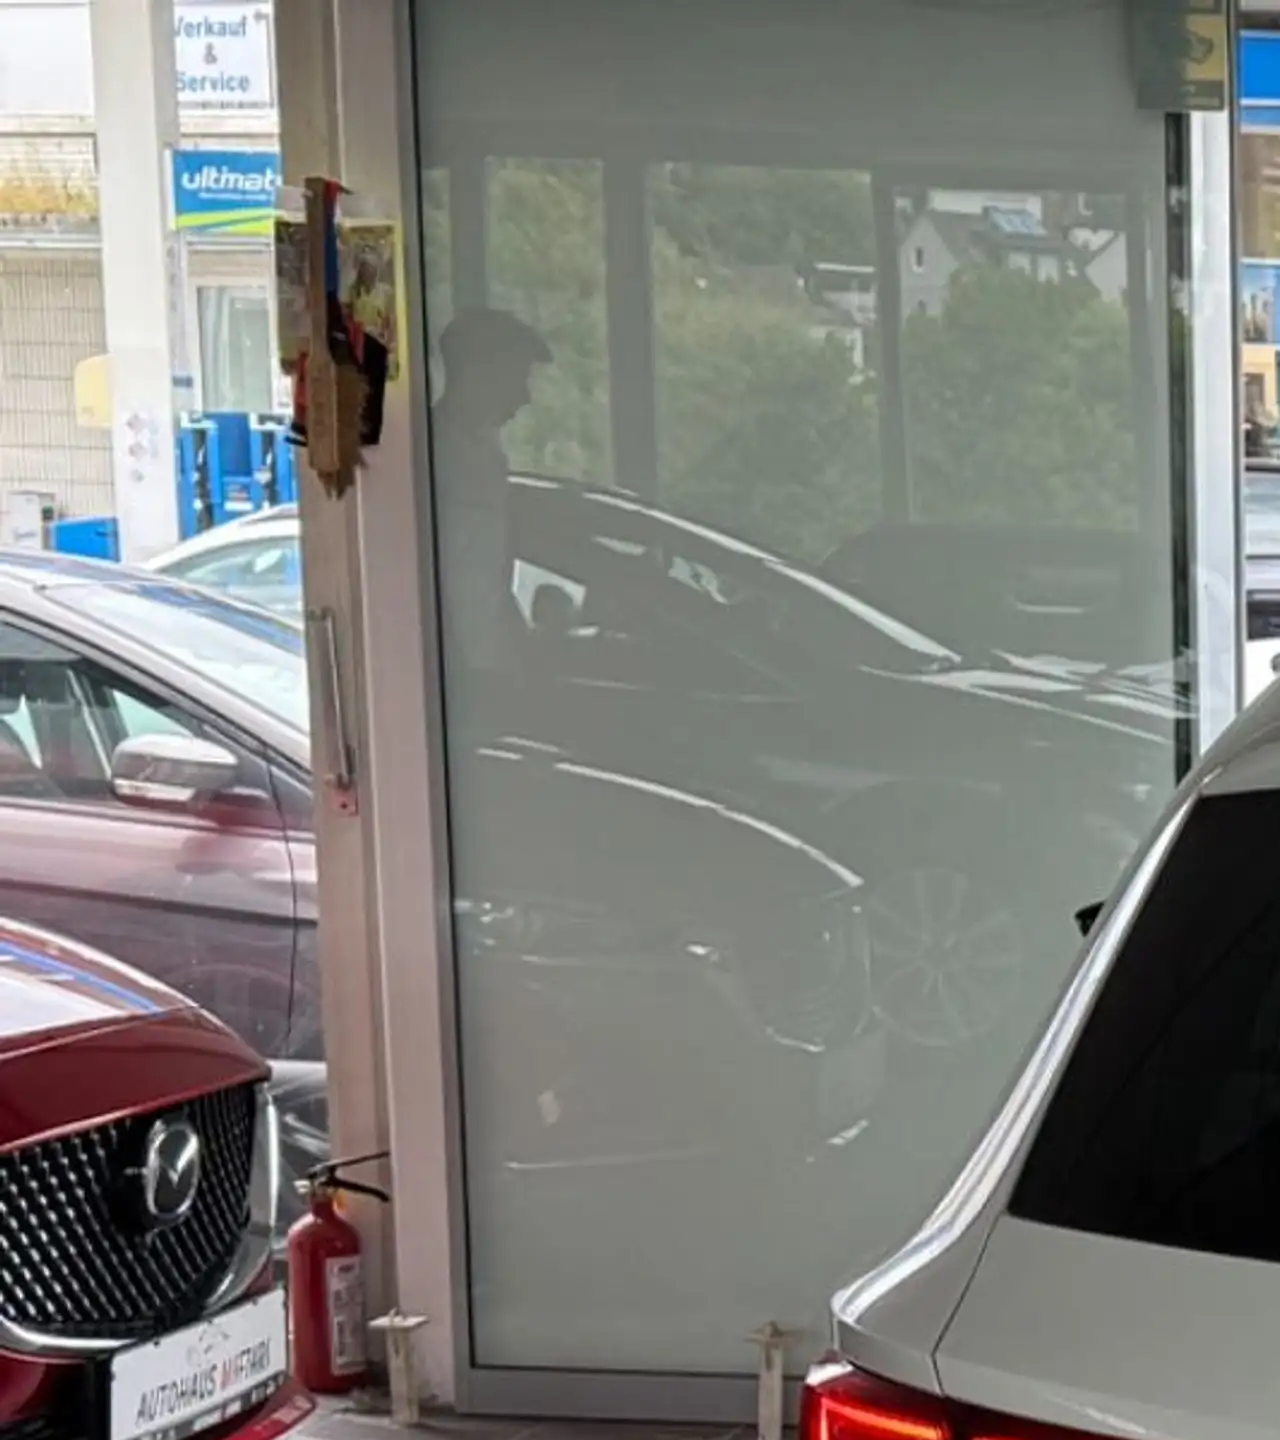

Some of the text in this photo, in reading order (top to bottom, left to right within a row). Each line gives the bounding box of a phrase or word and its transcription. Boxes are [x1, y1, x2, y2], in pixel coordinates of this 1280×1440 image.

[203, 42, 218, 65] &
[176, 70, 250, 93] Service
[135, 1363, 217, 1427] AUTOHAUS
